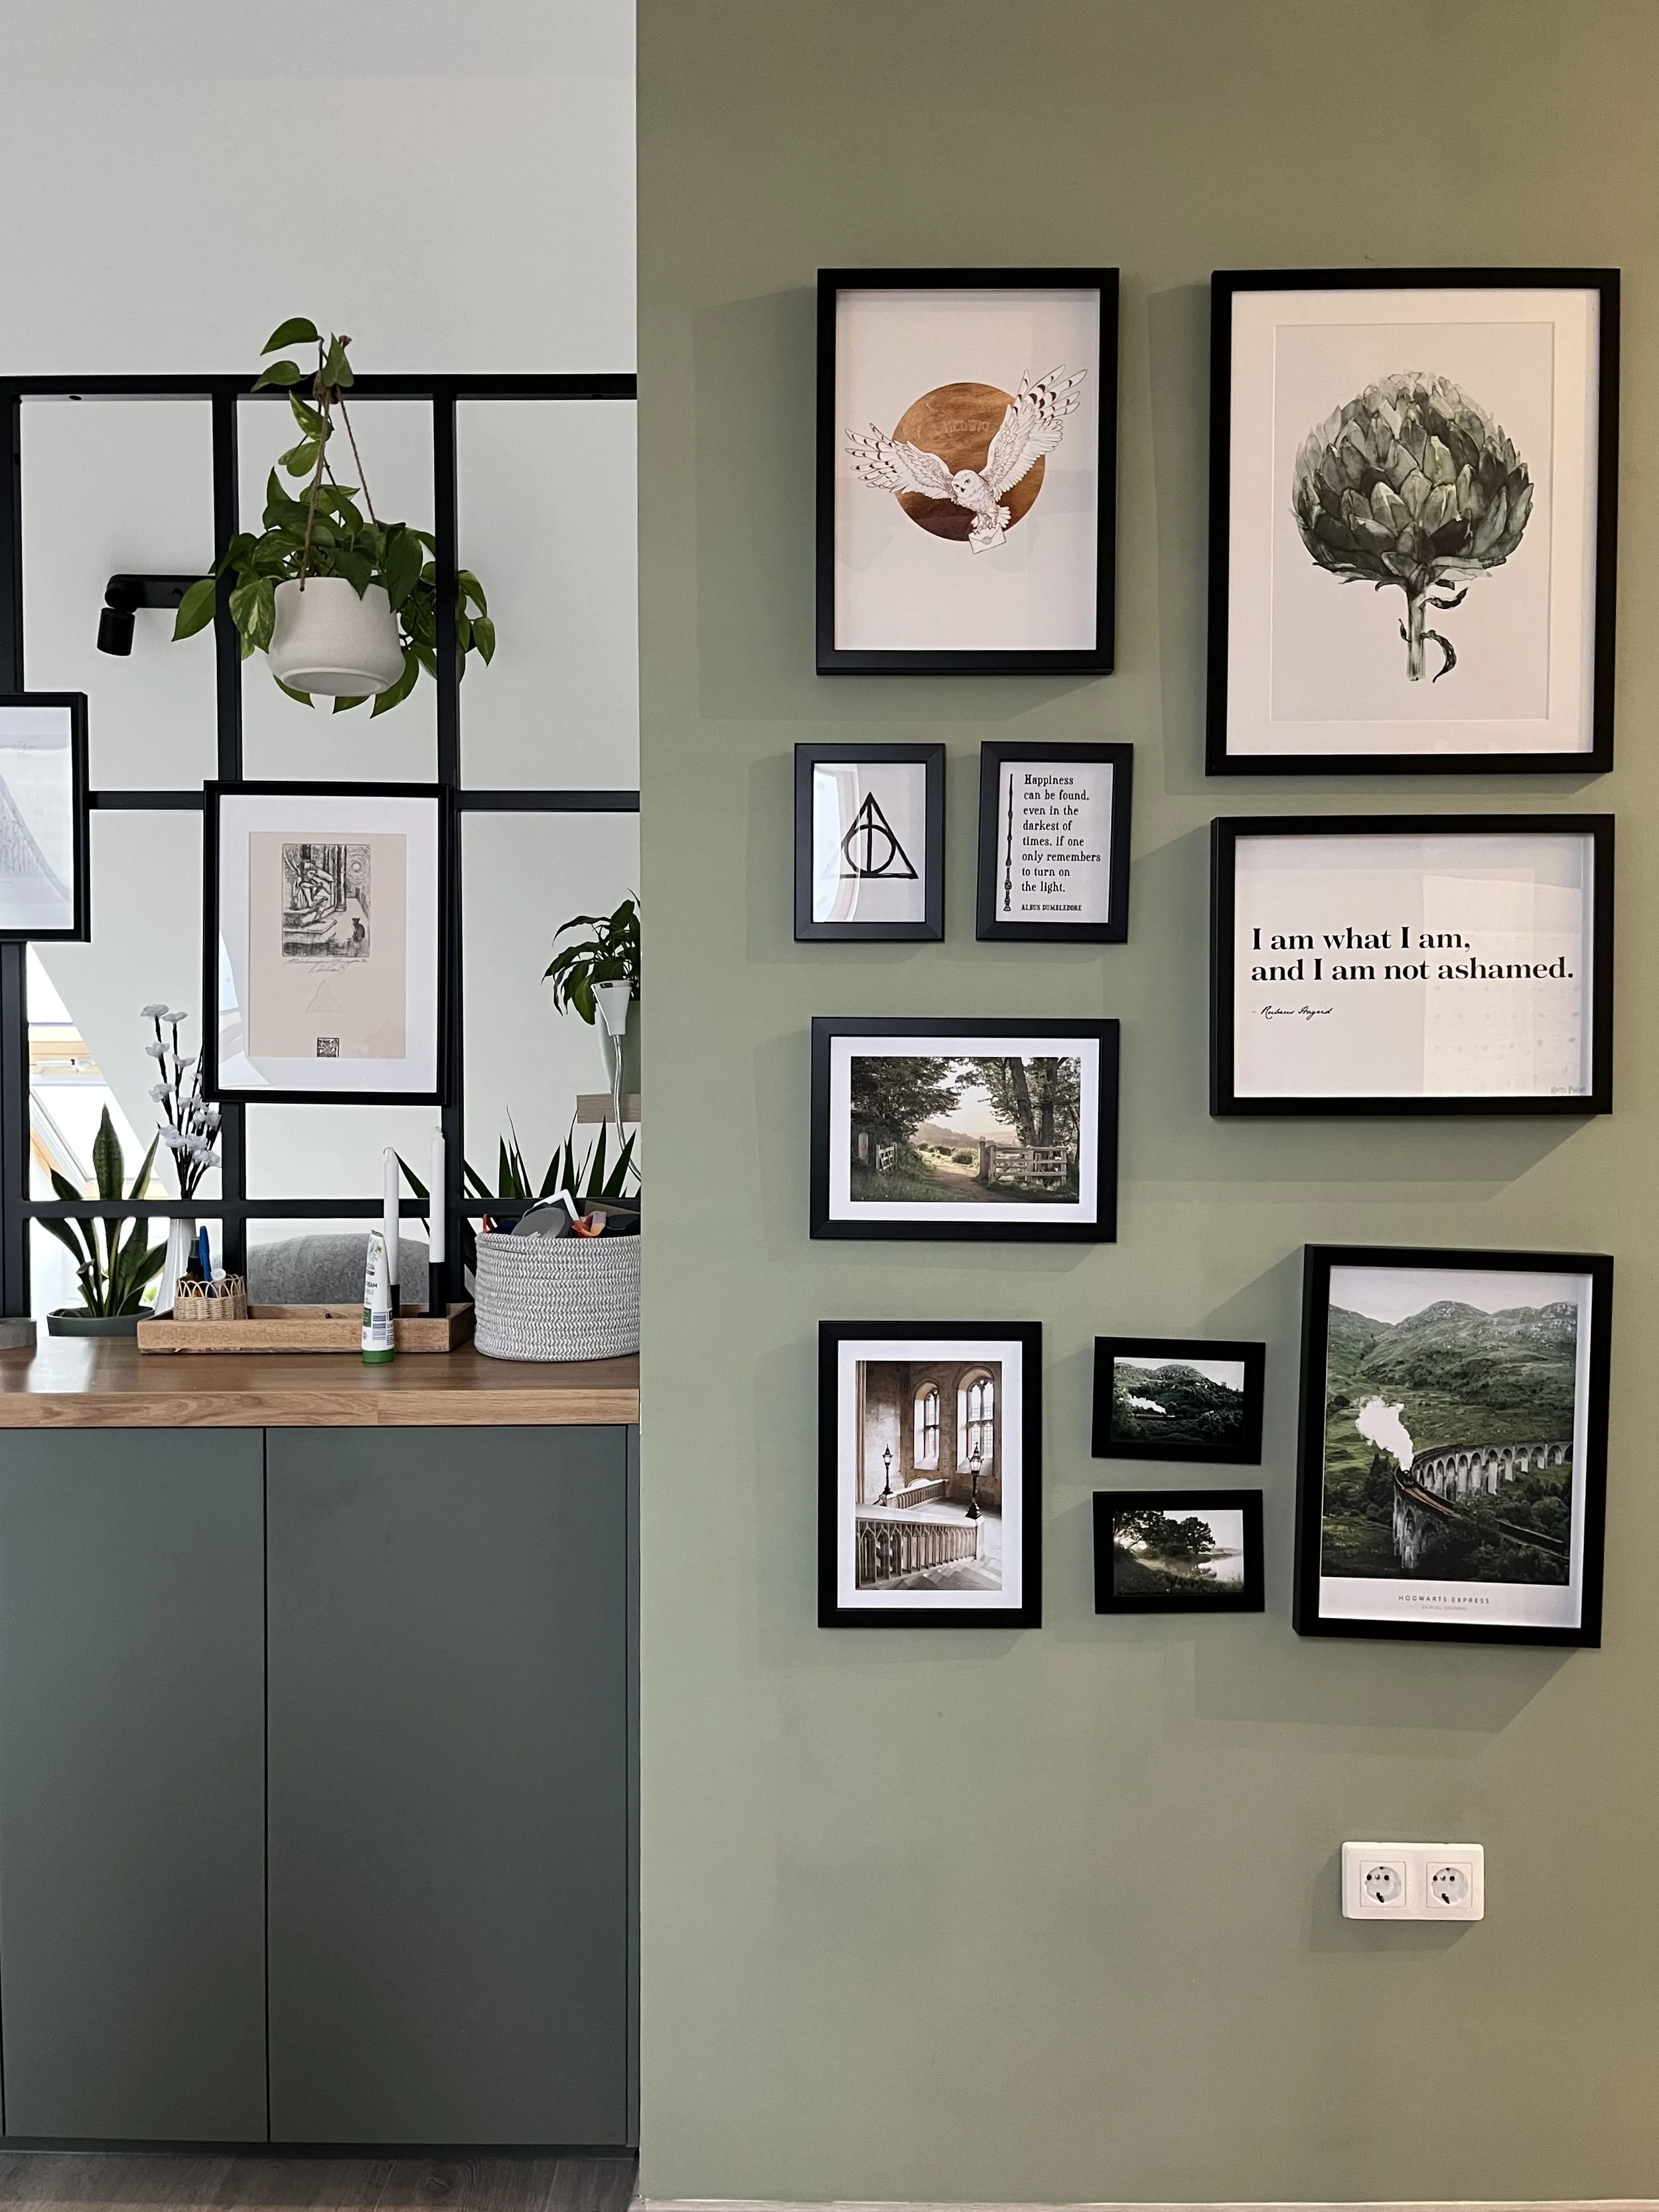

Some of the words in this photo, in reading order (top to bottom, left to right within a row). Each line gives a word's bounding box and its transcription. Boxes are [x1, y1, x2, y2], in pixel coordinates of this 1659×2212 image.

[1024, 774, 1074, 787] Happiness
[1045, 789, 1055, 800] be
[1049, 805, 1060, 815] in
[1063, 805, 1078, 815] the
[1023, 819, 1060, 831] darkest
[1062, 819, 1073, 831] of
[1056, 835, 1065, 846] if
[1022, 850, 1043, 863] only
[1046, 851, 1101, 862] remembers
[1022, 868, 1031, 876] to
[1034, 868, 1055, 876] turn
[1021, 880, 1037, 892] the
[1040, 880, 1065, 894] light.
[1253, 928, 1262, 950] I
[1270, 935, 1315, 950] am
[1323, 926, 1392, 949] what
[1401, 926, 1409, 949] I
[1419, 933, 1471, 953] am,
[1251, 958, 1305, 981] and
[1313, 958, 1323, 980] I
[1332, 965, 1376, 981] am
[1384, 960, 1430, 980] not
[1438, 956, 1573, 979] ashamed.
